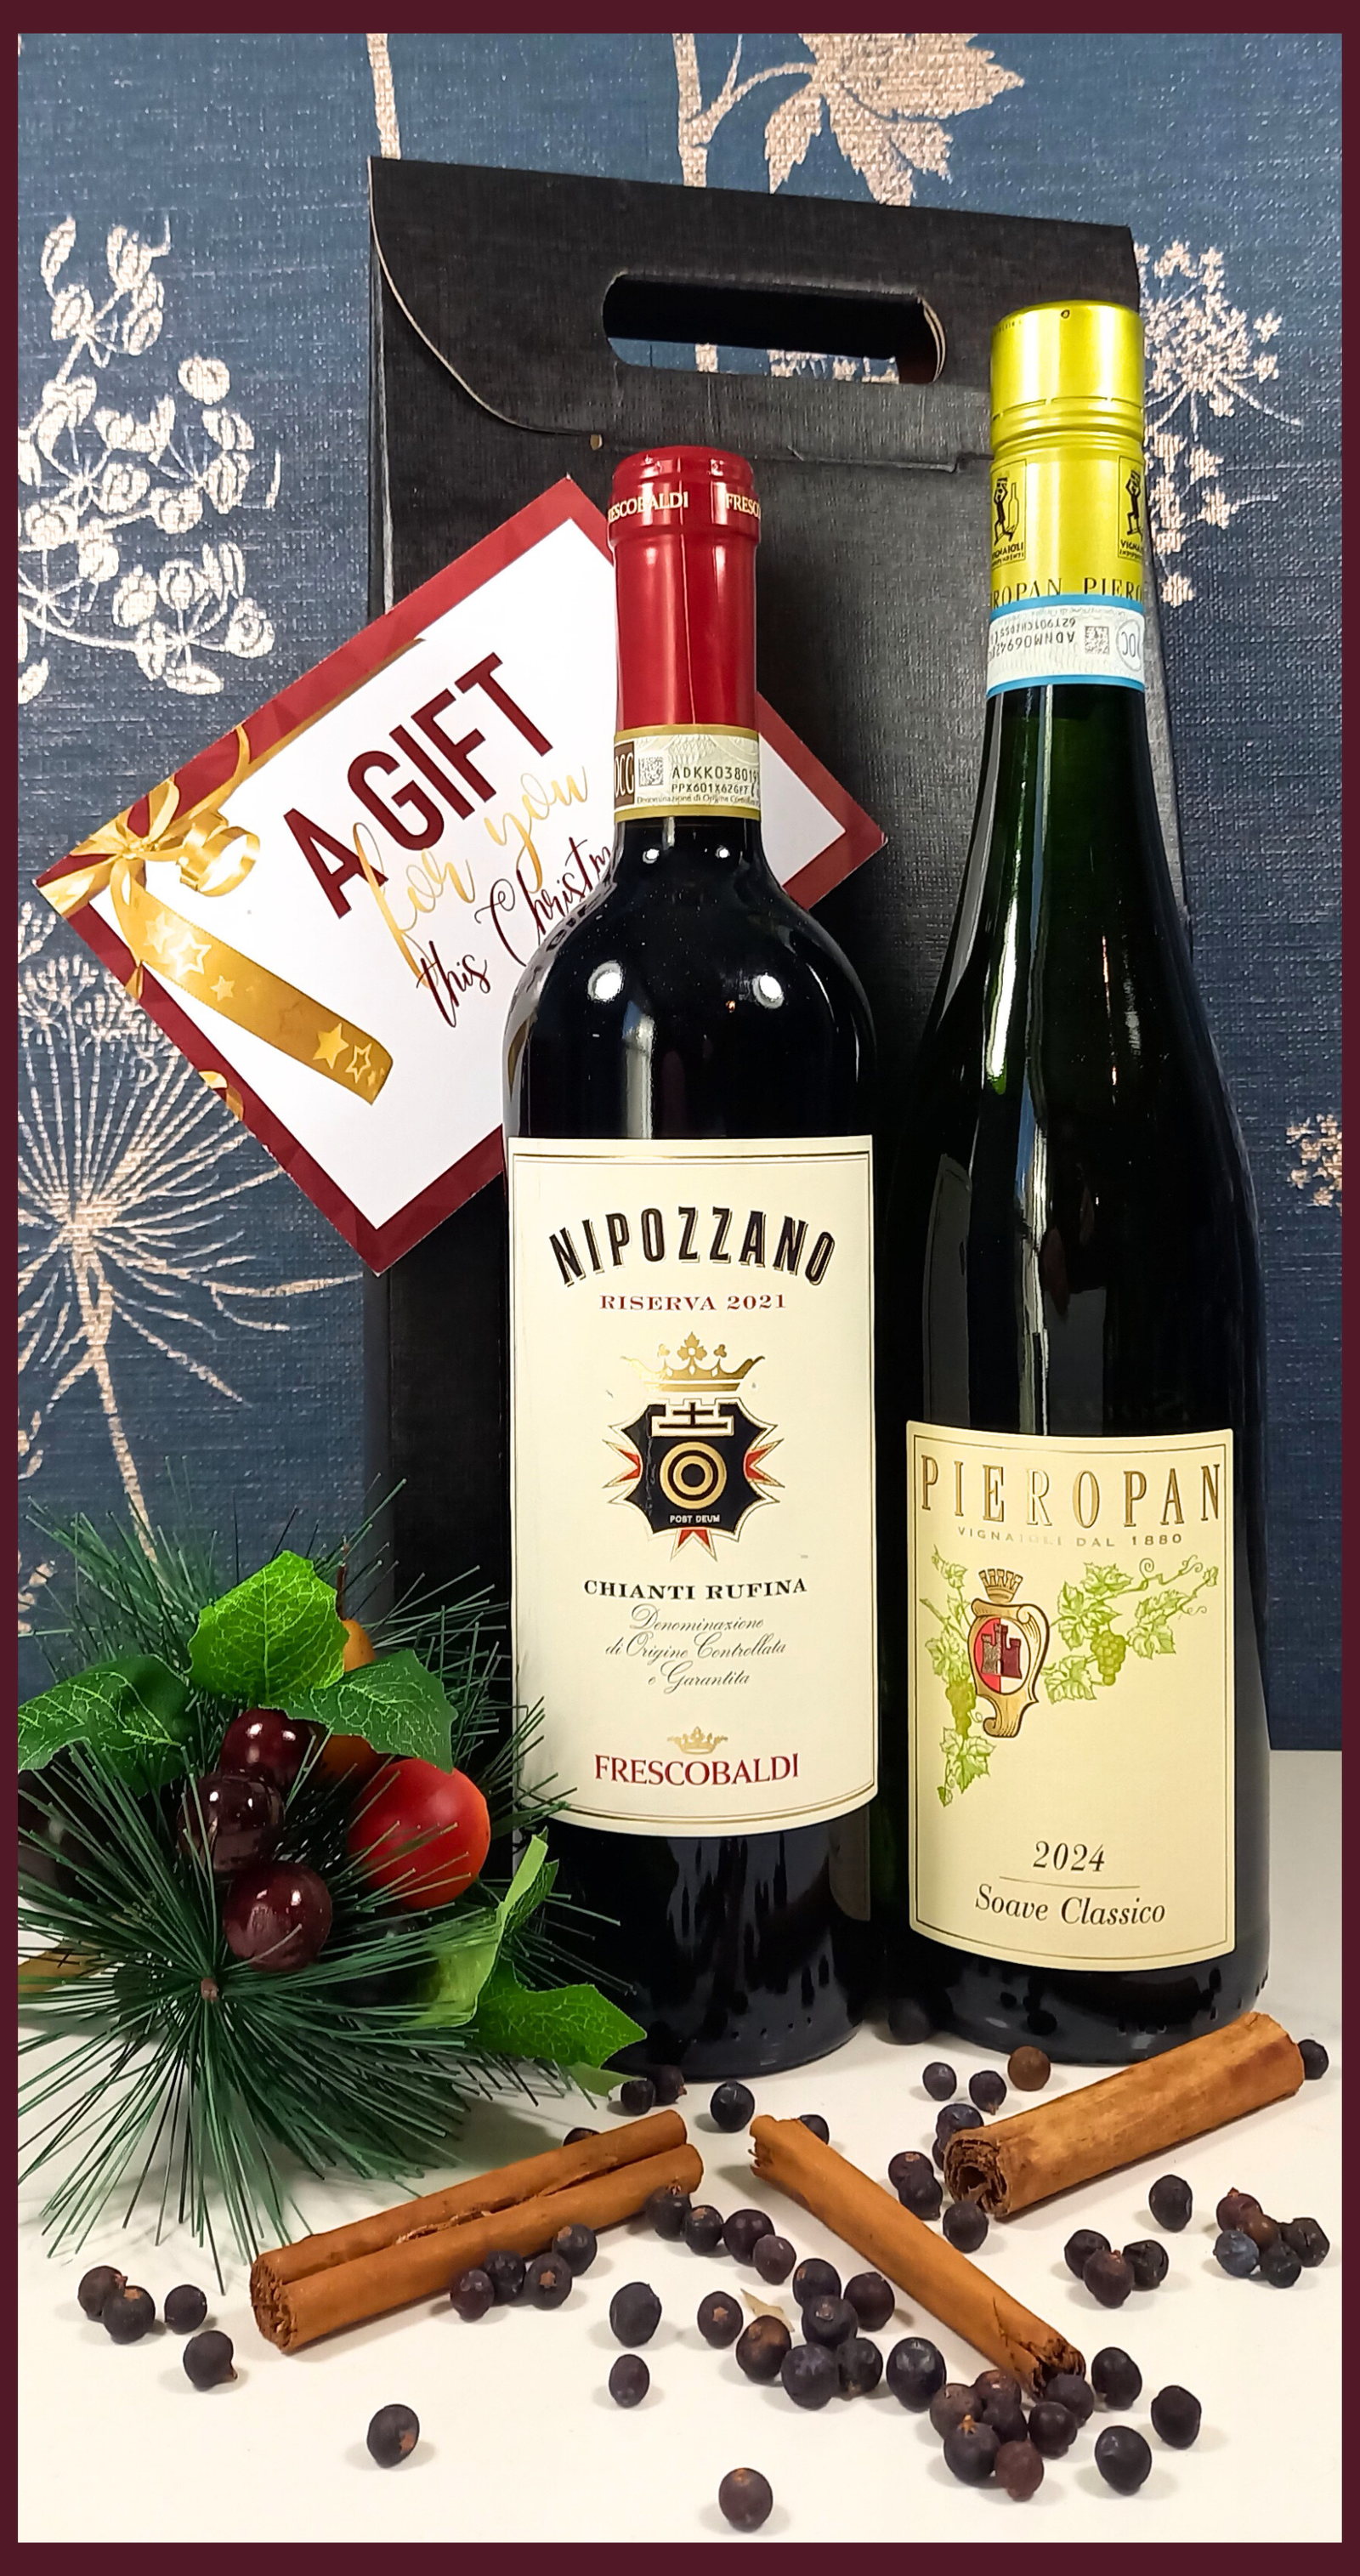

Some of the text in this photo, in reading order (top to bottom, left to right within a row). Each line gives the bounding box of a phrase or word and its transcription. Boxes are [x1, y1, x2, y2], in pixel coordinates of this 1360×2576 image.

[990, 578, 1062, 610] ROPAN
[284, 652, 553, 919] A GIFT
[353, 766, 588, 989] for you
[416, 941, 491, 1028] this
[549, 1206, 835, 1287] NIPOZZANO
[599, 1294, 786, 1311] RISERVA 2021
[921, 1455, 1220, 1529] PIEROPAN
[957, 1527, 1182, 1547] VIGNAIOLI DAL 1880
[584, 1578, 808, 1600] CHIANTI RUFINA
[630, 1603, 763, 1631] Denominazione
[605, 1631, 786, 1665] di Origine Controllata
[648, 1661, 750, 1694] e Garantita
[595, 1753, 799, 1786] FRESCOBALDI
[1033, 1841, 1106, 1872] 2024
[975, 1884, 1165, 1925] Soave Classico
